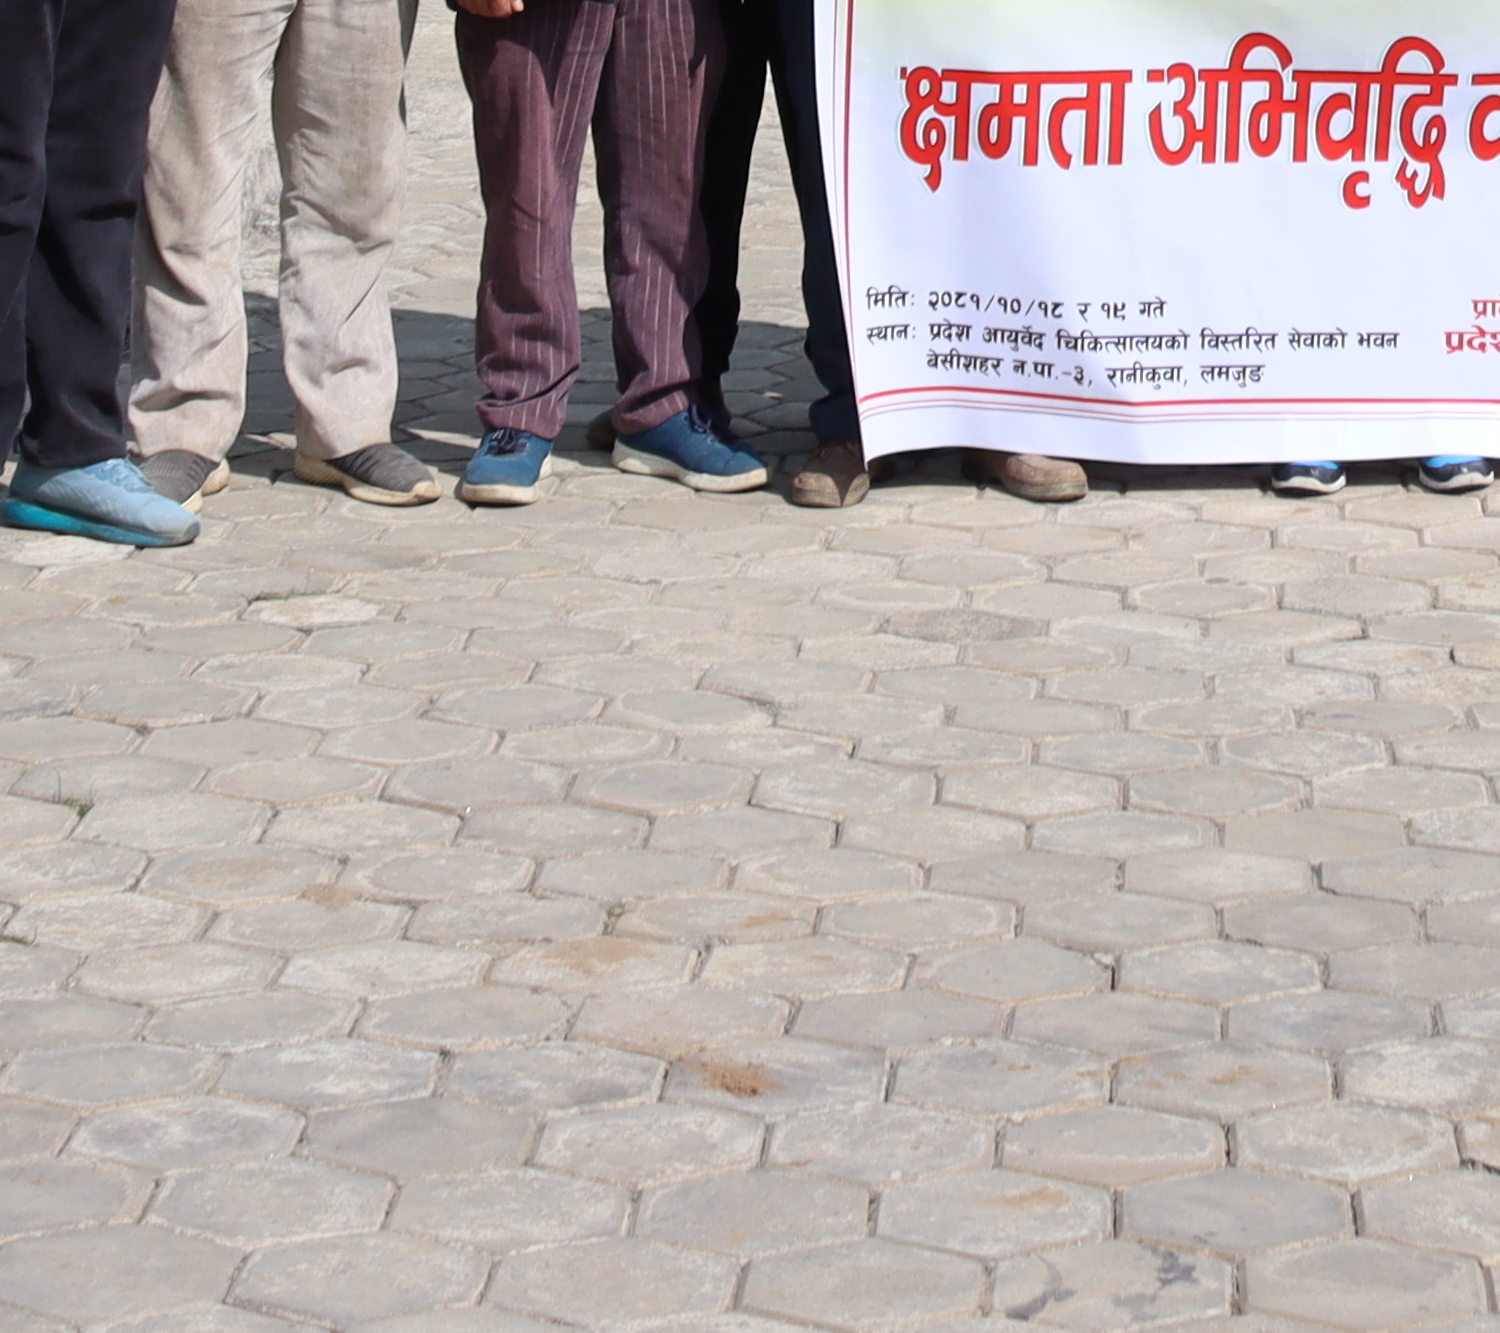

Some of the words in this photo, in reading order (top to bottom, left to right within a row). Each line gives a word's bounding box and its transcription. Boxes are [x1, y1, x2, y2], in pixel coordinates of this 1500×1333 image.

[899, 66, 1133, 193] क्षमता
[1077, 301, 1091, 323] र
[1100, 302, 1127, 321] १९
[1139, 296, 1167, 319] गते
[929, 319, 972, 343] प्रदेश
[982, 324, 1046, 352] आयुर्वेद
[1056, 328, 1190, 354] चिकित्सालयको
[1200, 327, 1278, 353] विस्तरित
[1288, 327, 1348, 351] सेवाको
[1357, 331, 1400, 350] भवन
[927, 348, 1004, 377] बेसीशहर
[1199, 364, 1265, 388] लमजुङ
